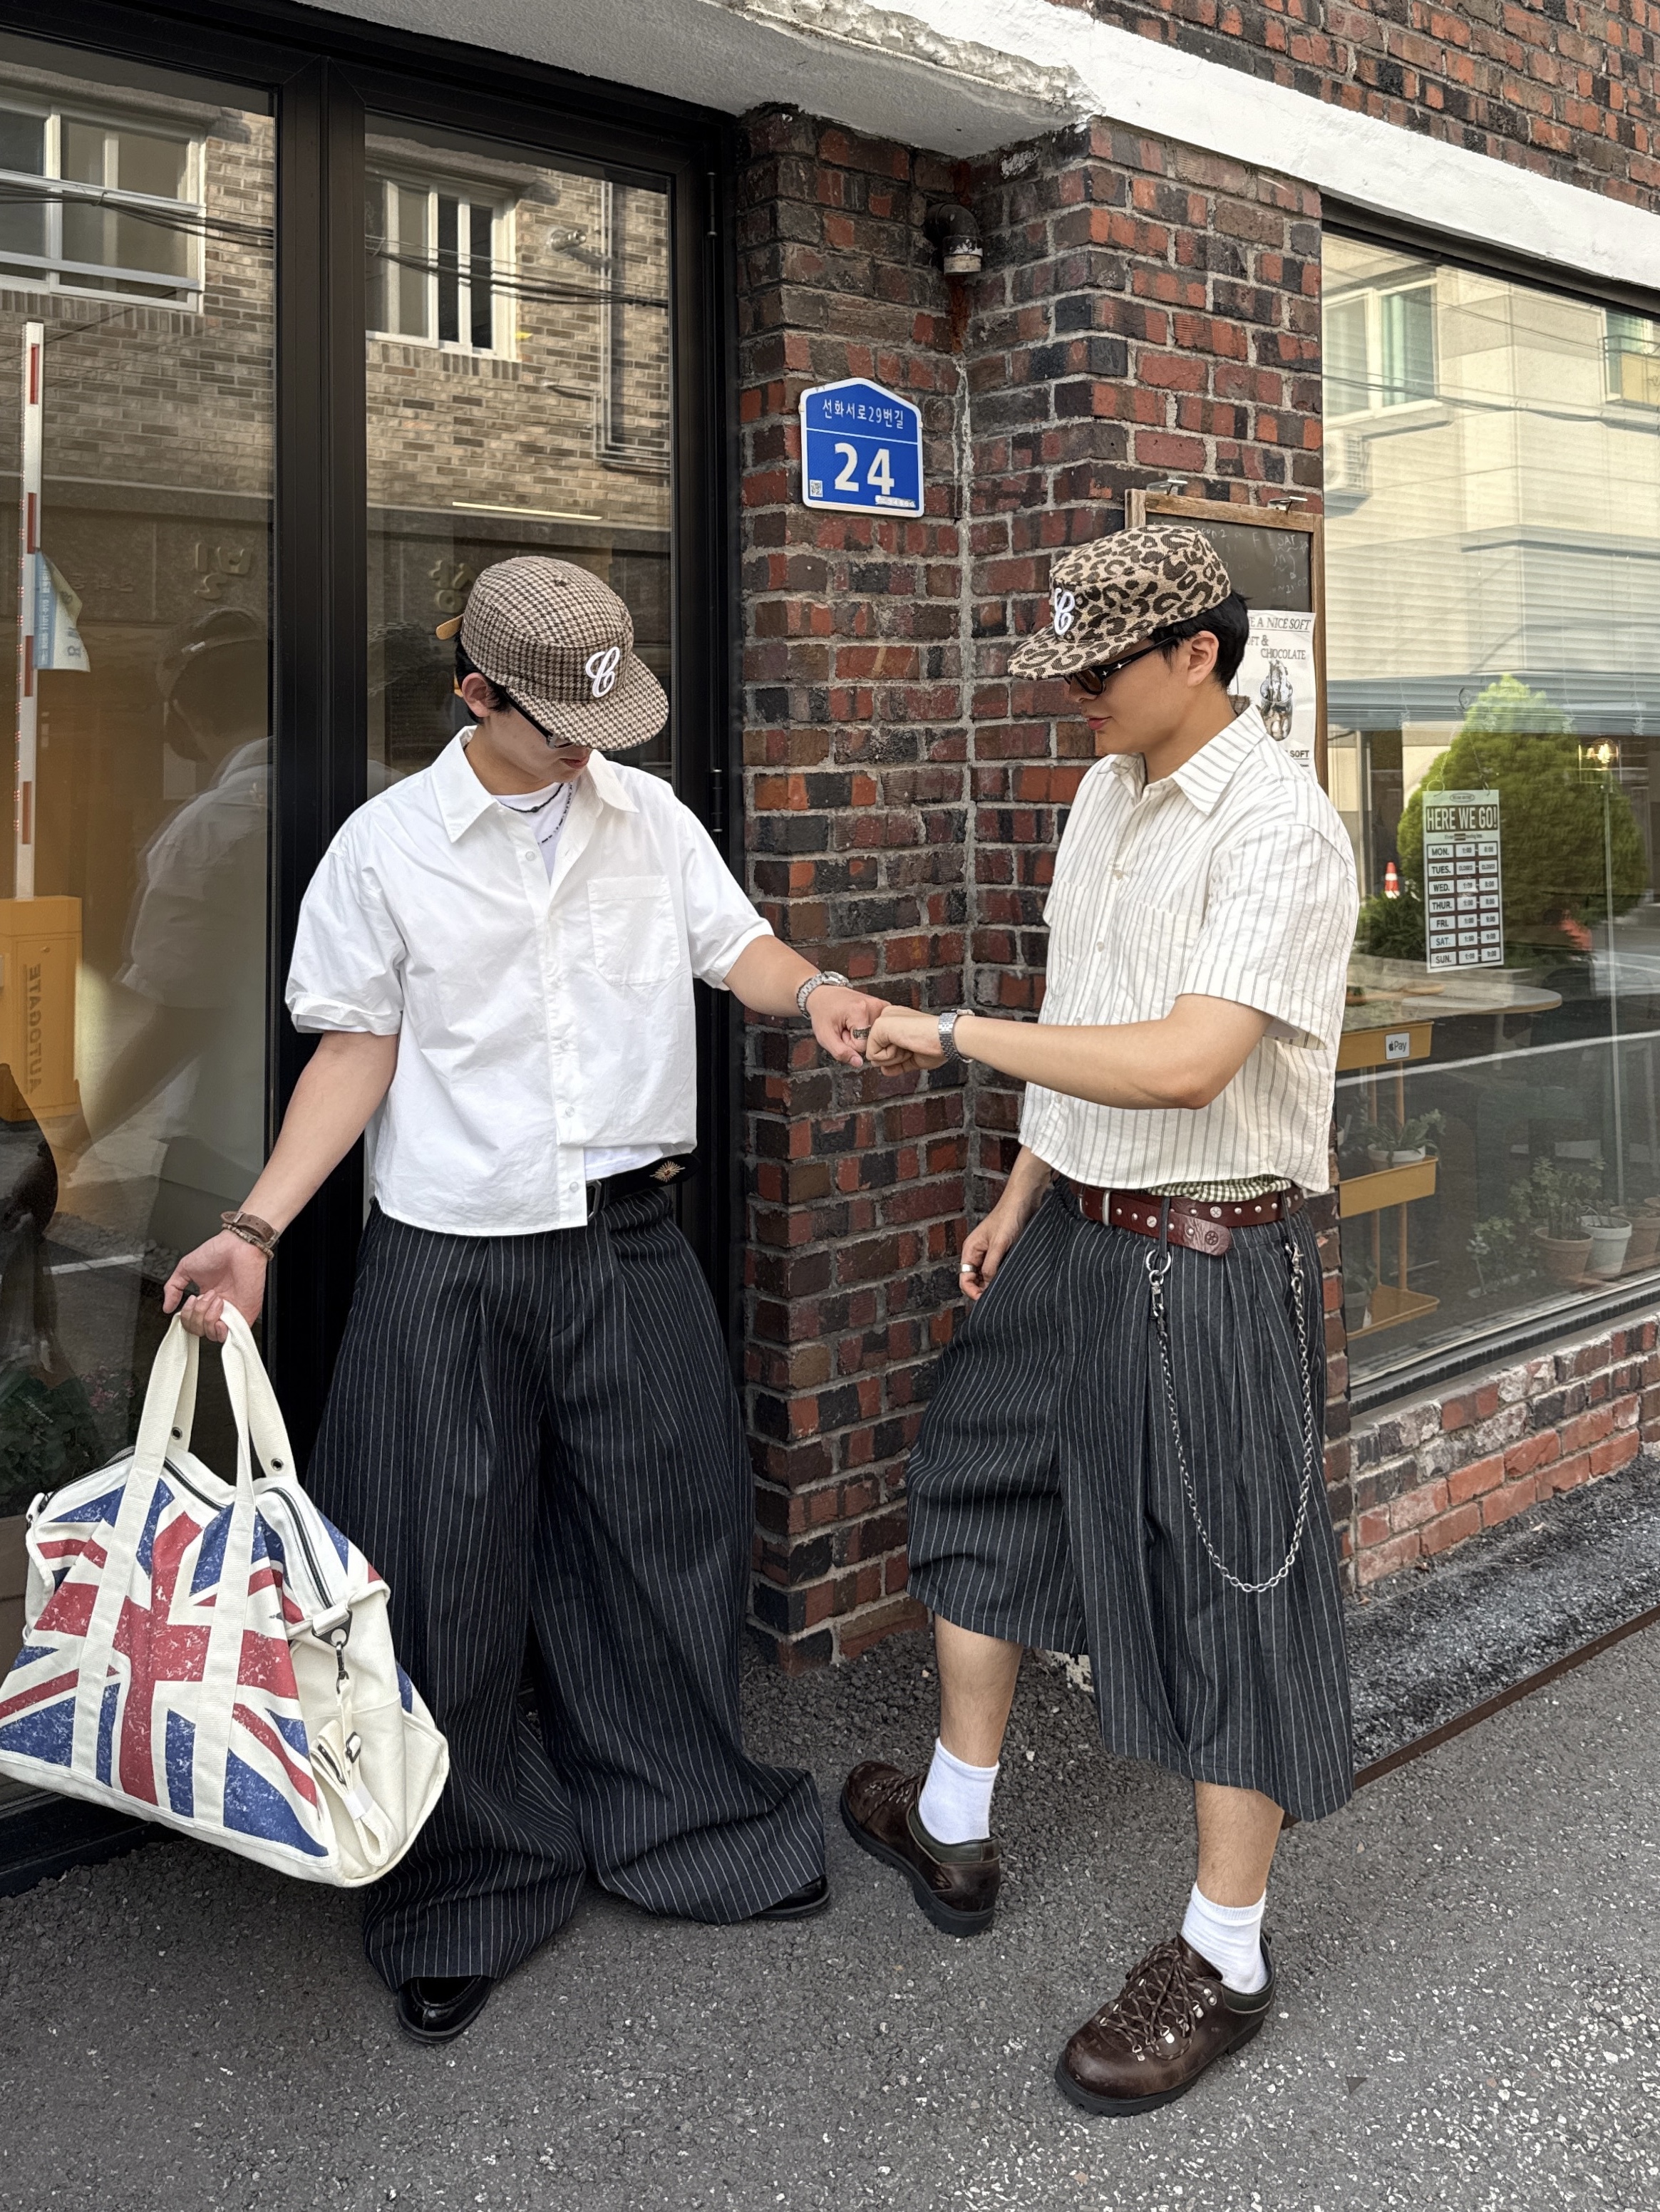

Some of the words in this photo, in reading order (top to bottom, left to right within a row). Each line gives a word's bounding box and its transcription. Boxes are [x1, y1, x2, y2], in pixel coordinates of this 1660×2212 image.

[822, 398, 904, 430] 선화서로29번길
[834, 442, 895, 495] 24
[1278, 533, 1295, 547] SAT
[1257, 616, 1264, 628] A
[1267, 617, 1289, 629] NICE
[1289, 618, 1311, 630] SOFT
[1261, 635, 1269, 646] &
[1261, 648, 1306, 660] CHOCOLATE
[1289, 750, 1309, 758] SOFT
[1427, 807, 1456, 830] HERE
[1458, 807, 1476, 830] WE
[1478, 806, 1497, 829] GO!
[1431, 847, 1449, 856] MON.
[1431, 865, 1451, 874] TUES.
[1432, 901, 1453, 910] THUR.
[1436, 919, 1449, 928] FRI.
[1435, 937, 1450, 946] SAT.
[1435, 955, 1451, 963] SUN.
[1394, 1040, 1407, 1053] Pay
